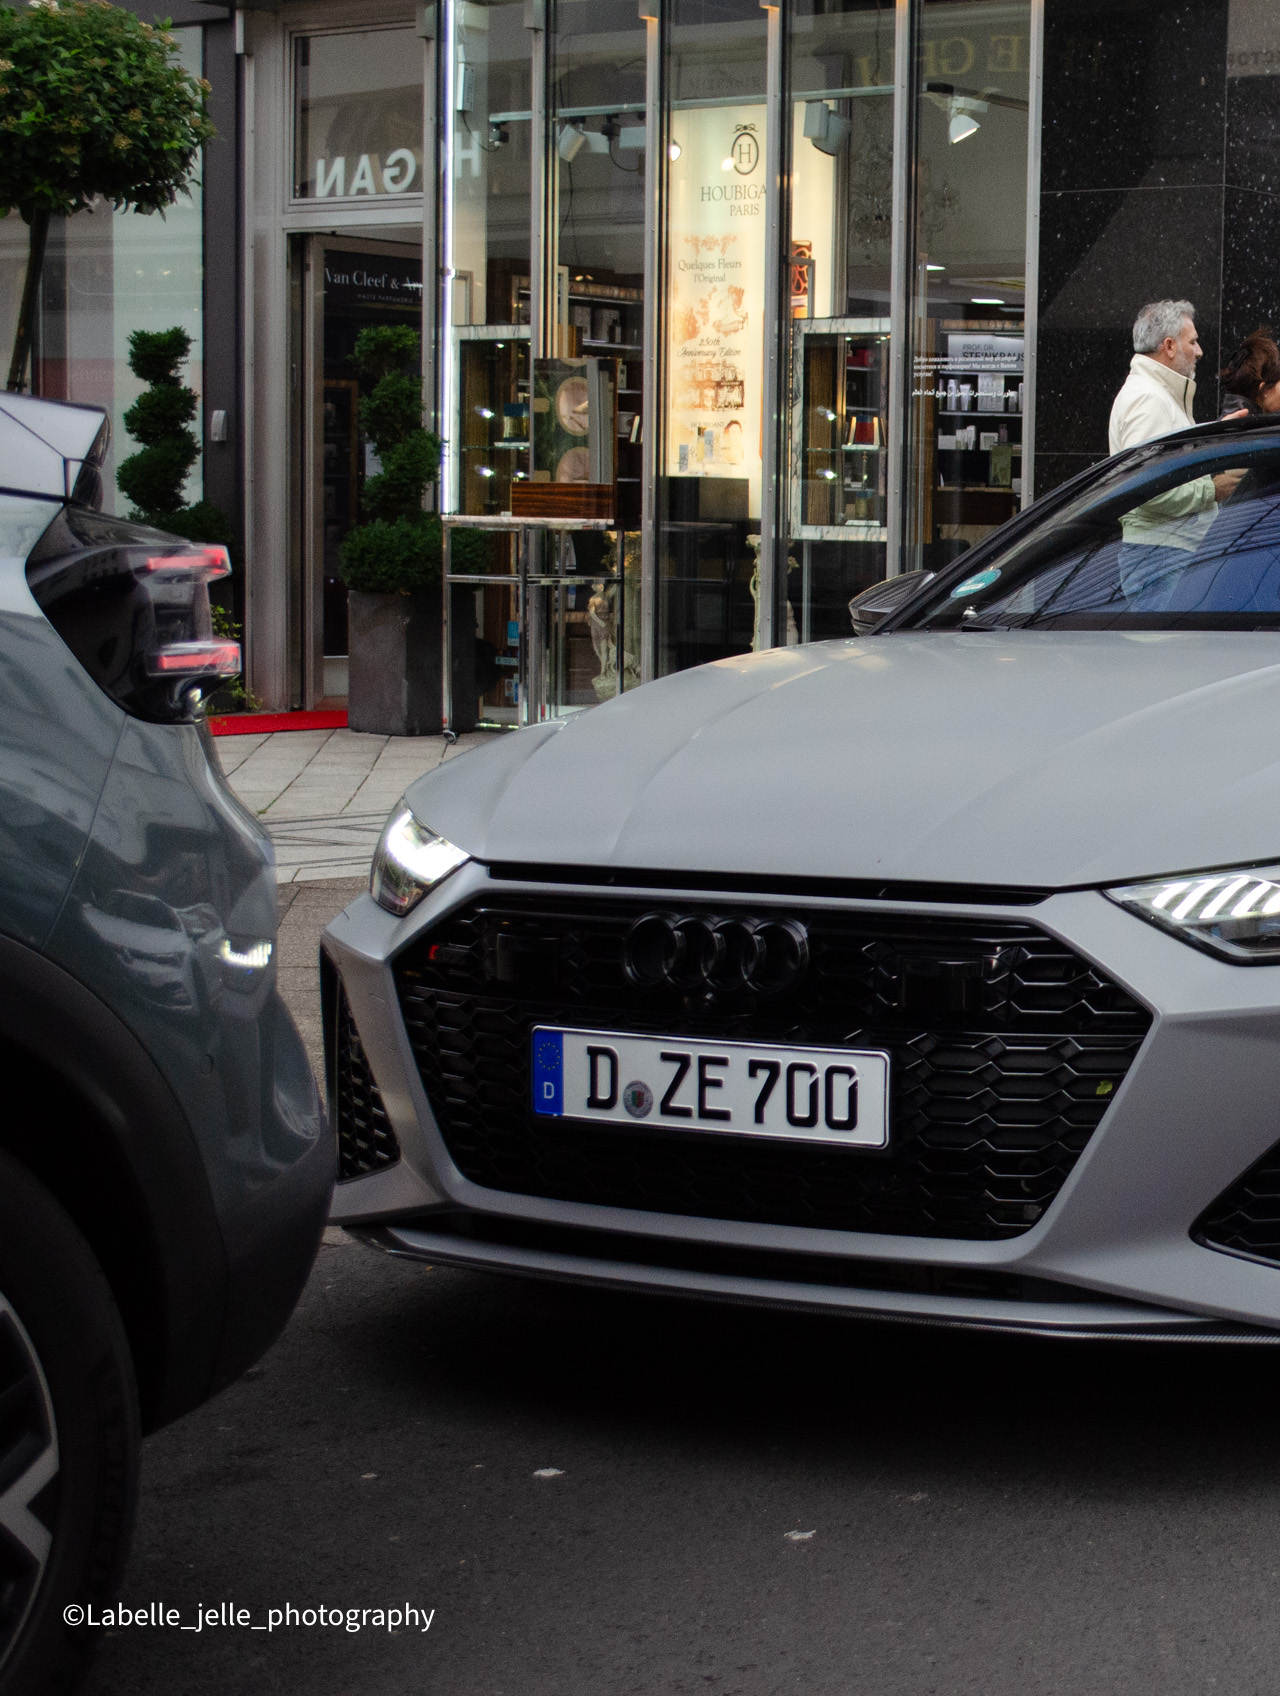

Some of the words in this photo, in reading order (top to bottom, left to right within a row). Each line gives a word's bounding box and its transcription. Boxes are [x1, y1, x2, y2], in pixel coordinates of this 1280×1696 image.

[730, 203, 760, 217] PARIS
[678, 259, 716, 271] Quelques
[718, 258, 742, 269] Fleurs
[325, 267, 350, 285] Van
[352, 270, 388, 288] Cleef
[390, 277, 400, 290] &
[694, 273, 726, 283] l'Original
[698, 338, 720, 346] 250th
[718, 347, 742, 357] Edition
[543, 1081, 555, 1099] D
[587, 1044, 619, 1110] D
[659, 1051, 732, 1122] ZE
[748, 1058, 859, 1131] 700
